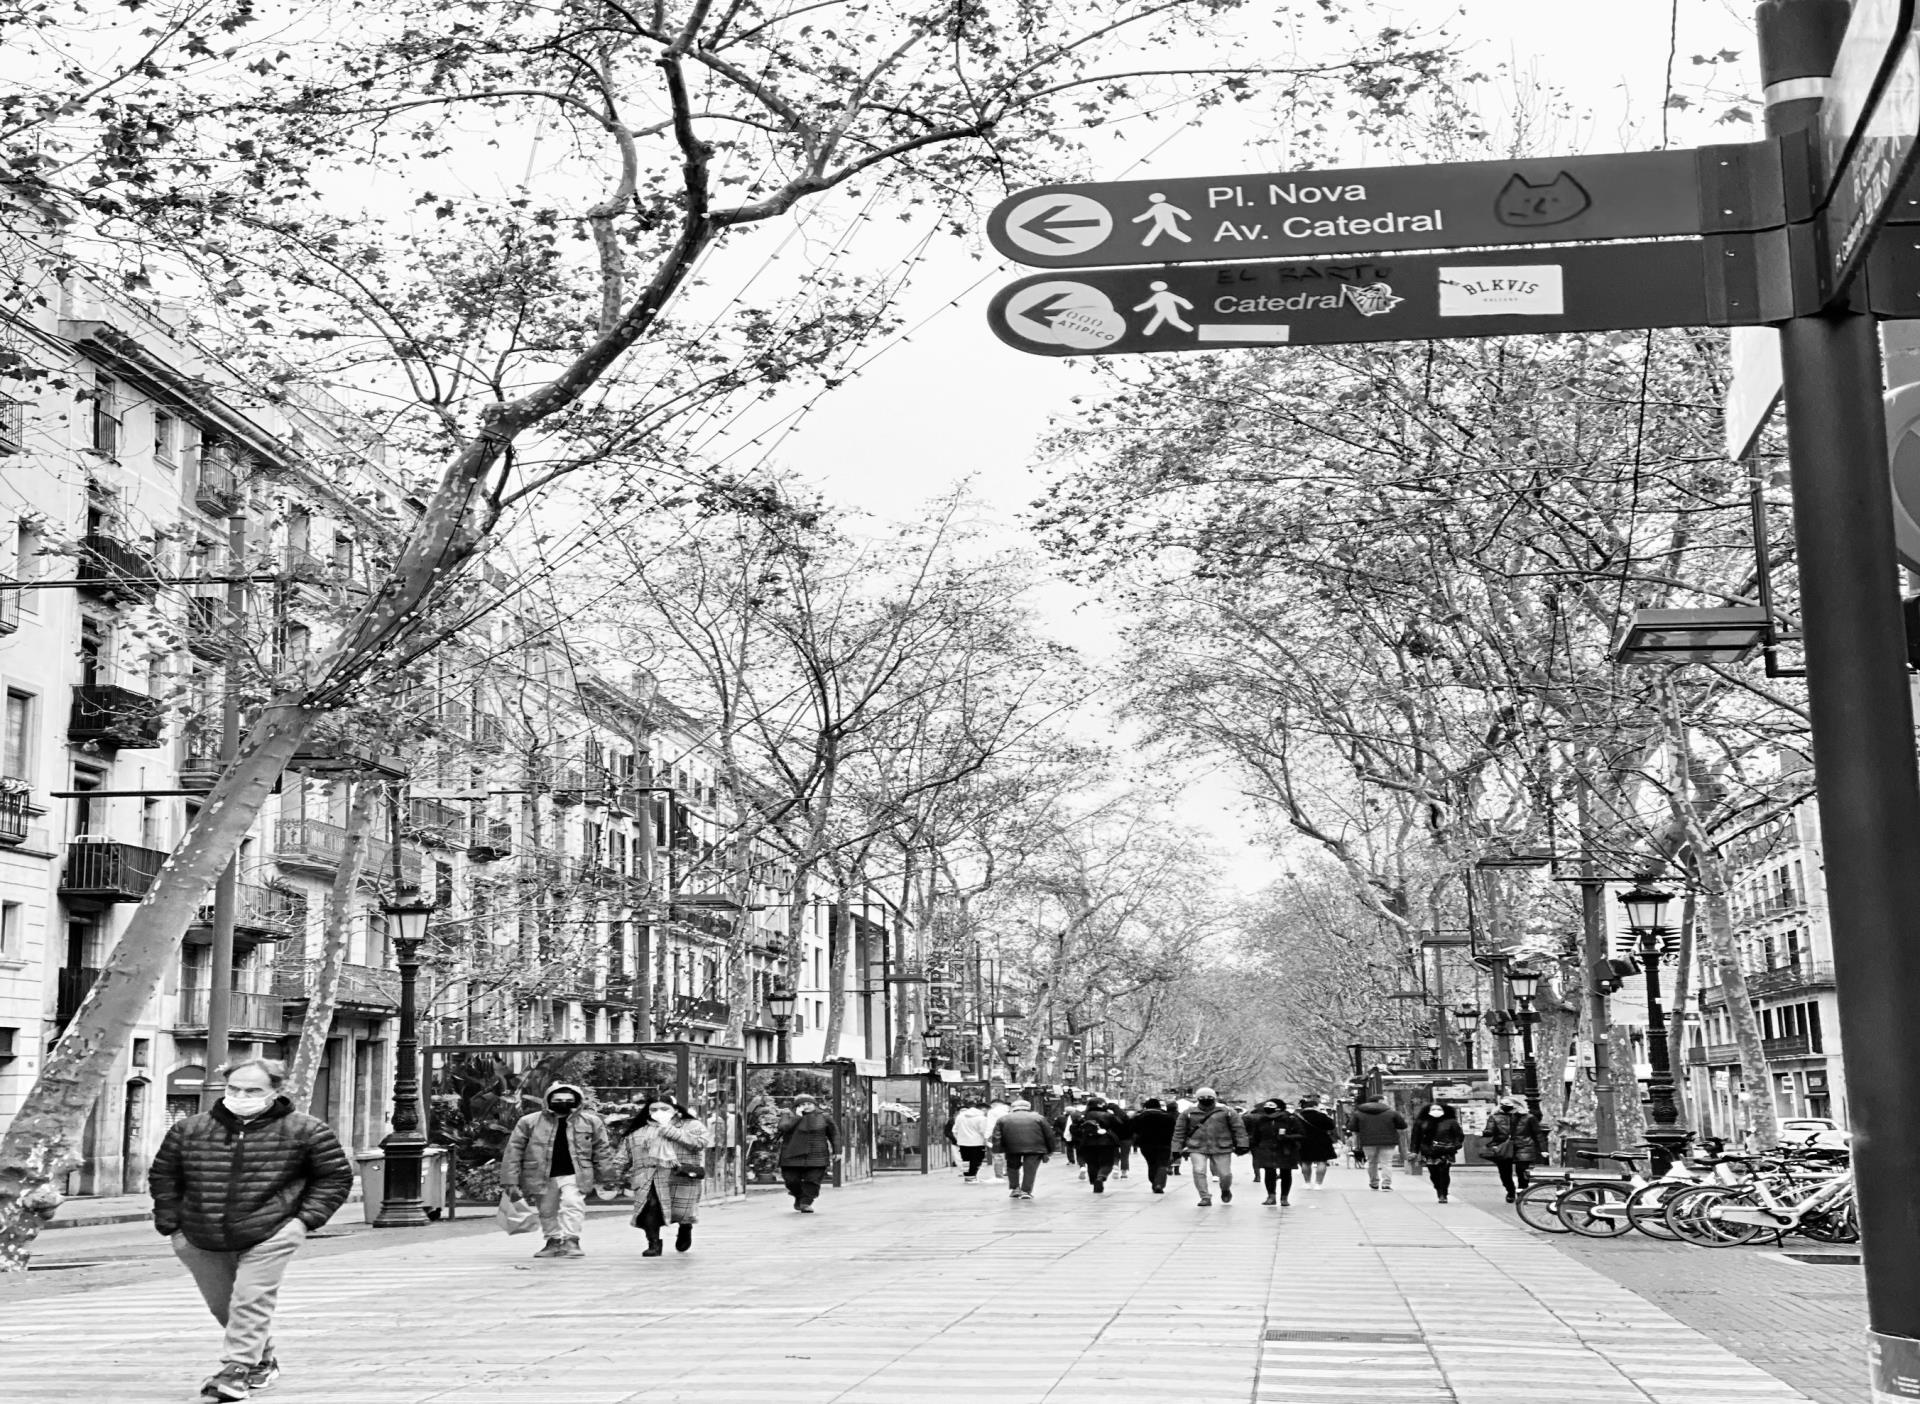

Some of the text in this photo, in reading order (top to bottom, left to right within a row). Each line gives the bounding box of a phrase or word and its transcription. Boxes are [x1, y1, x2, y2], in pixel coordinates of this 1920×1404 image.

[1208, 183, 1367, 208] Pl. Nova
[1213, 209, 1443, 242] Av. Catedral
[1462, 279, 1539, 296] BLKVIS
[1214, 290, 1346, 314] Catedral
